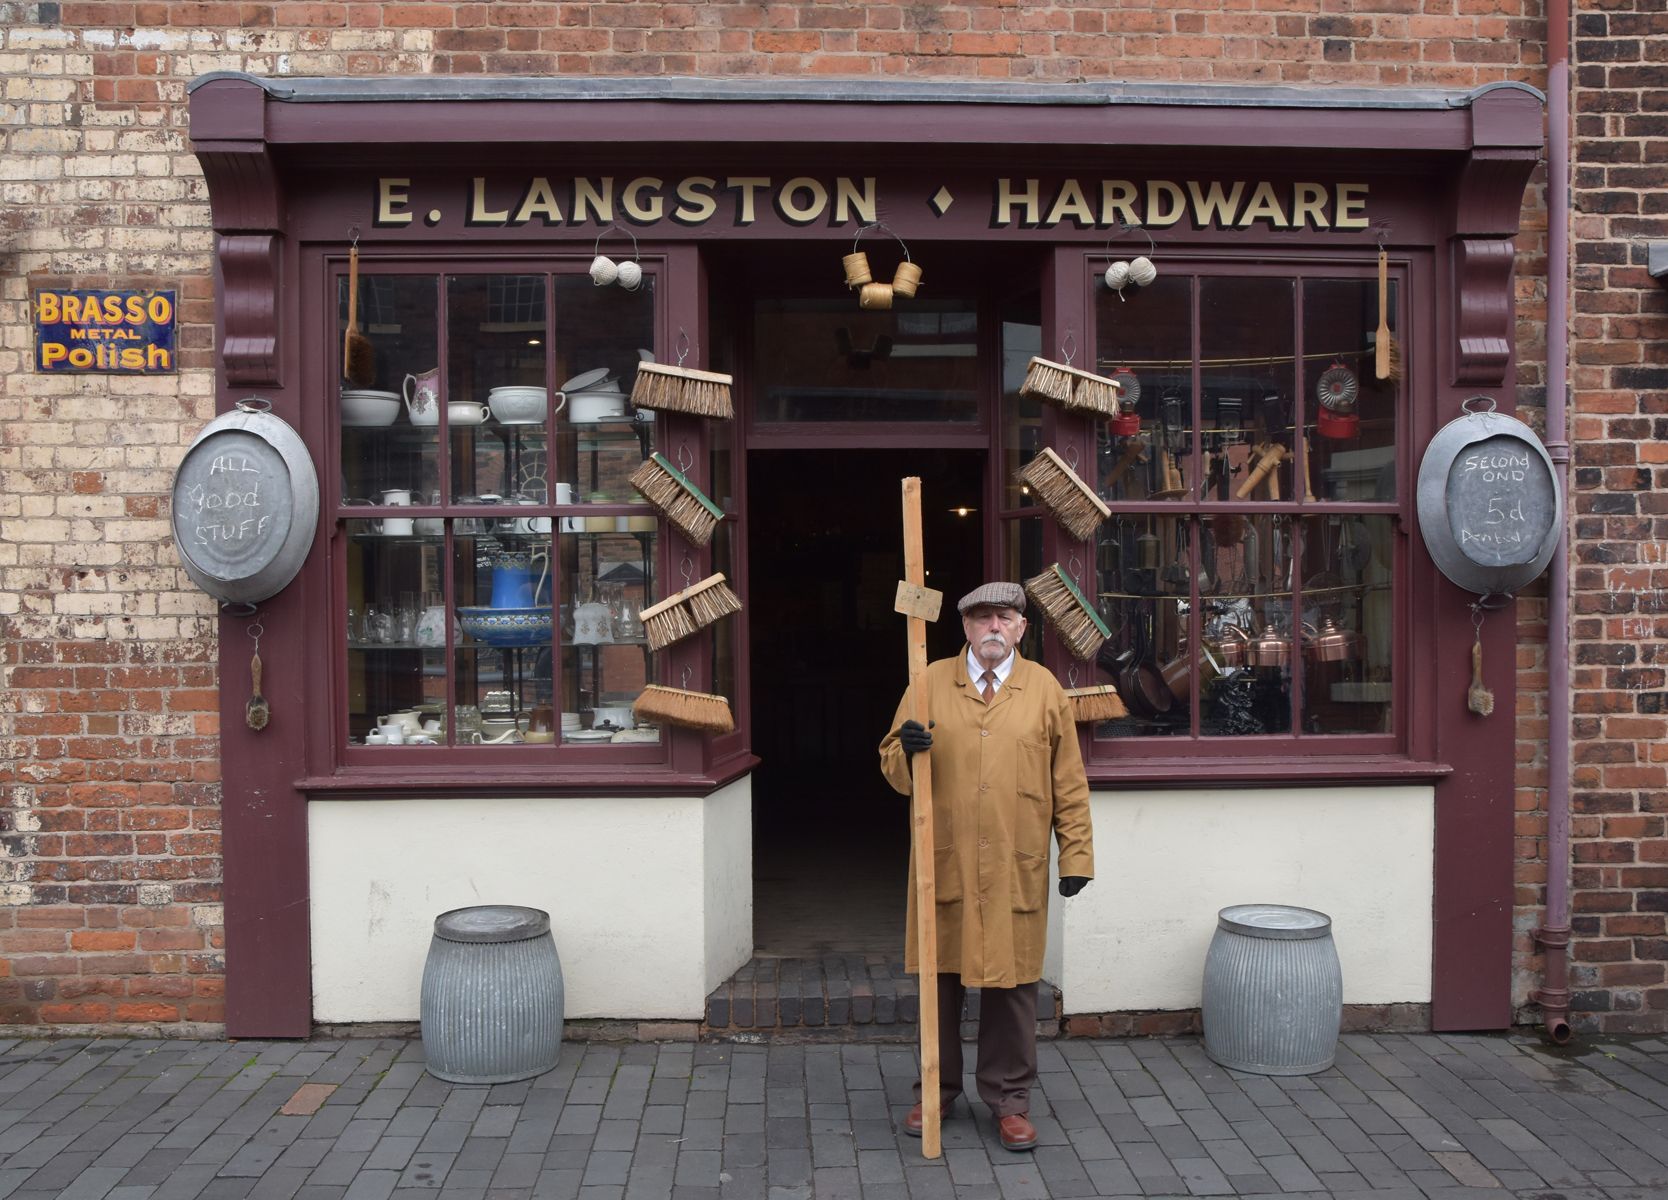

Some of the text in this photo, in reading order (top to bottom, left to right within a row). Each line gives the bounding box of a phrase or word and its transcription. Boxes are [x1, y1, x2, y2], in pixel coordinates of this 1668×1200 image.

[375, 177, 1370, 229] E. LANGSTON HARDWARE
[39, 292, 173, 325] BRASSO
[69, 328, 142, 340] METAL
[41, 342, 171, 369] Polish
[209, 455, 260, 476] ALL
[193, 515, 272, 546] STUFF
